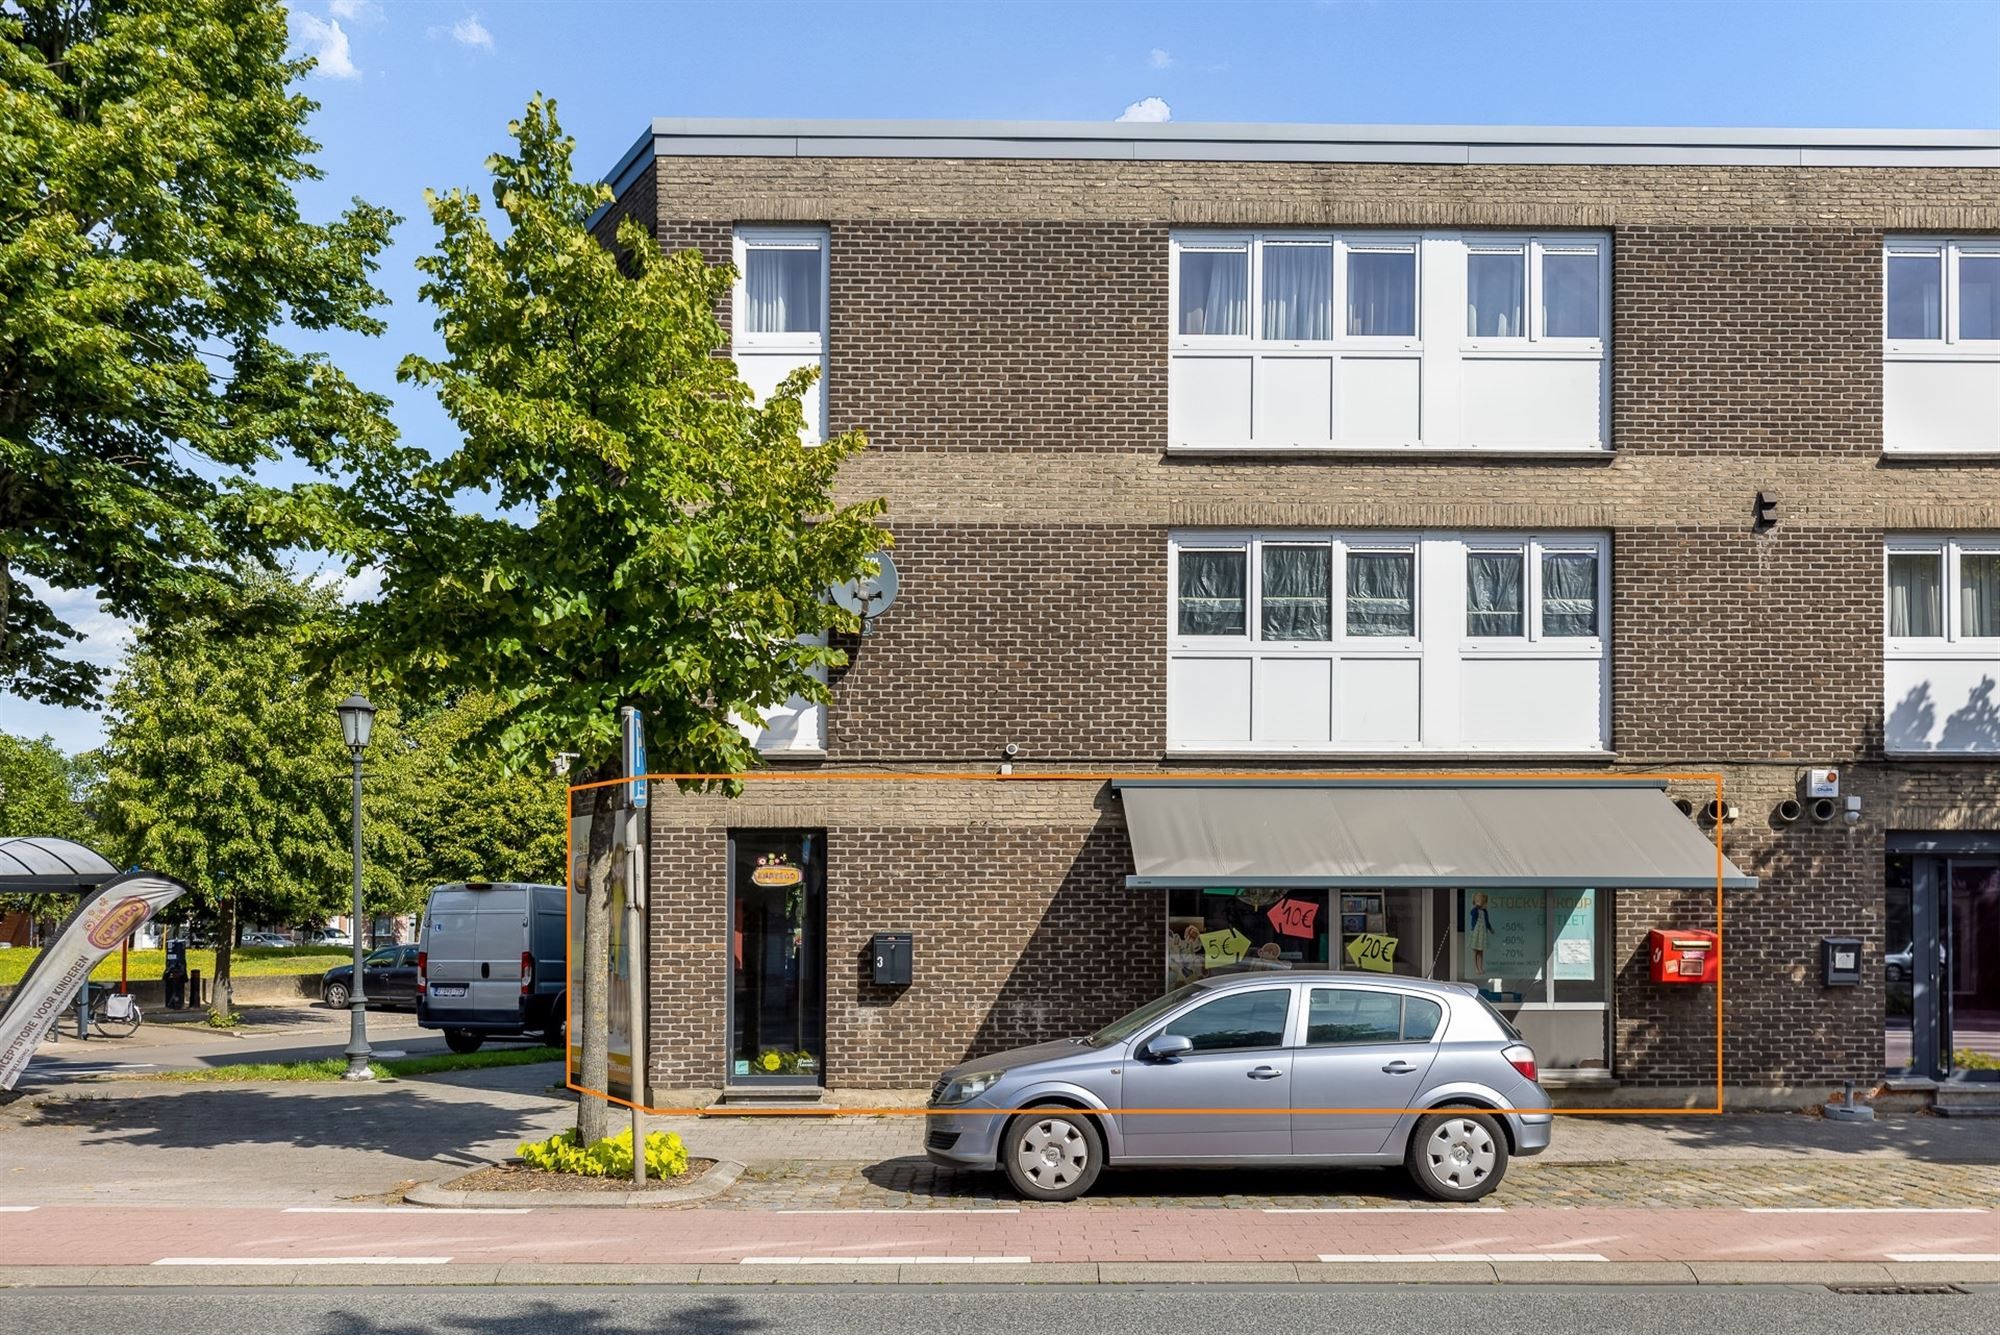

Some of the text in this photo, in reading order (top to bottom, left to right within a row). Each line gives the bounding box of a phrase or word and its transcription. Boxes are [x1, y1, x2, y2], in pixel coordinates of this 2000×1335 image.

[1283, 906, 1314, 928] 10€
[877, 956, 883, 967] 3
[1361, 938, 1395, 962] 20€
[0, 955, 89, 1076] NCEPTSTORE VOOR KINDEREN
